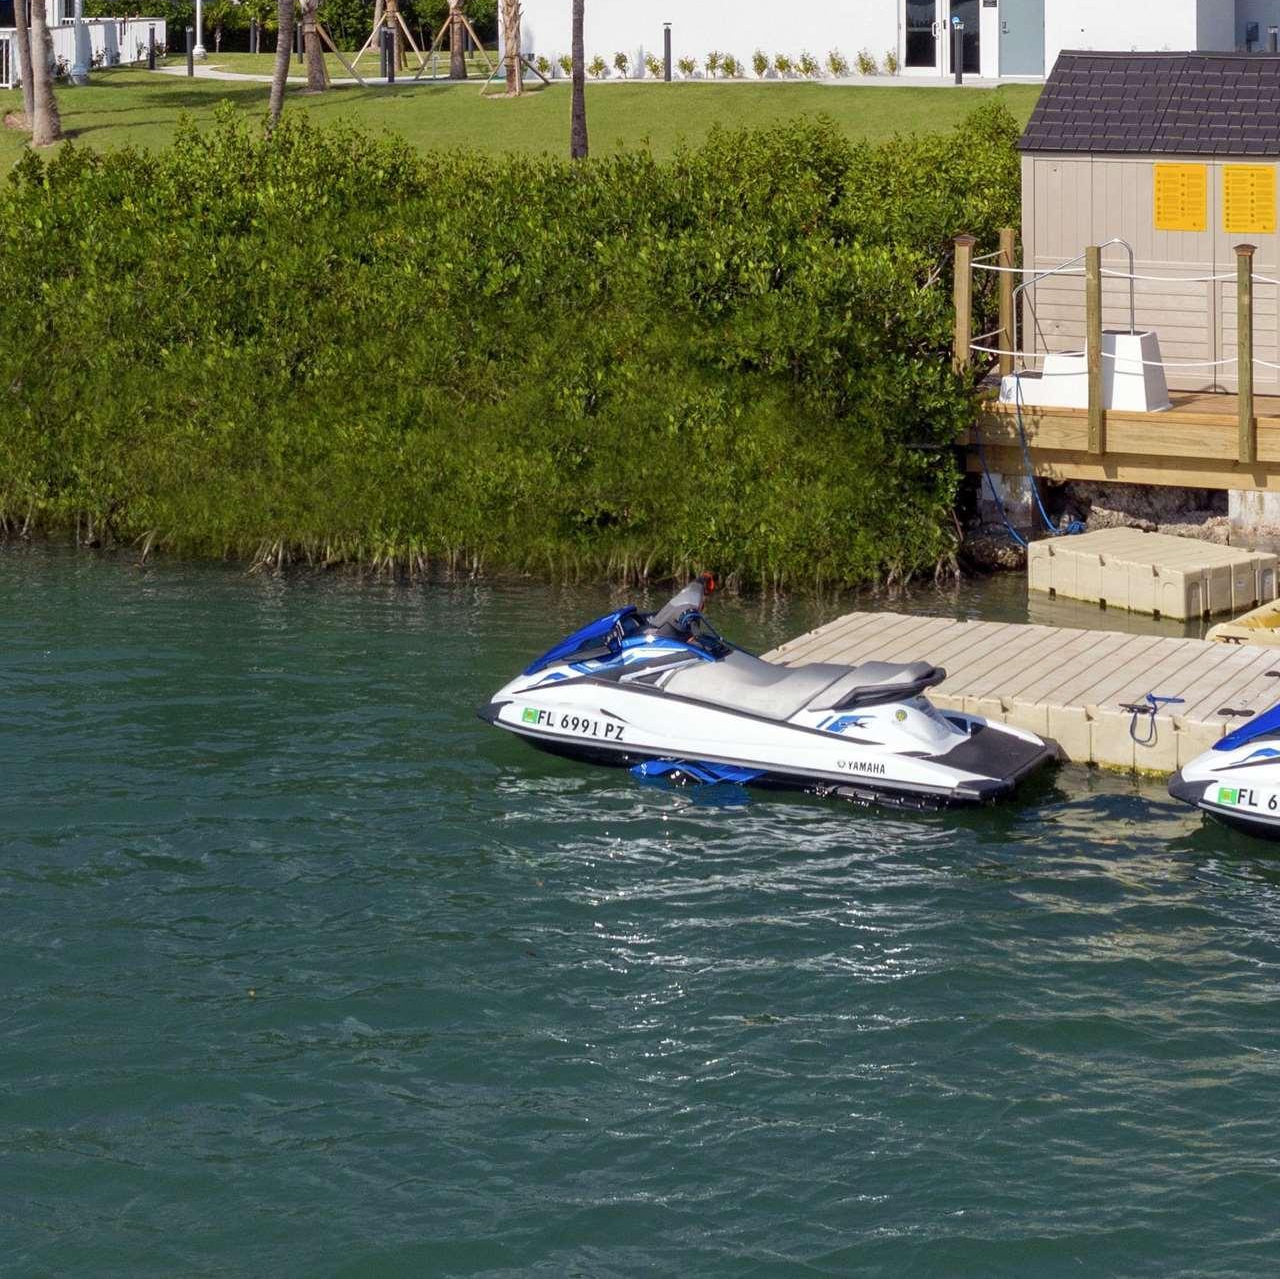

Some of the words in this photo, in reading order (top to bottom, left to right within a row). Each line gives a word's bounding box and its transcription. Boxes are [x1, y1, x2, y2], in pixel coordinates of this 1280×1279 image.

[537, 710, 554, 727] FL
[561, 714, 598, 736] 6991
[605, 723, 624, 741] PZ
[848, 760, 885, 775] YAMAHA
[1237, 788, 1258, 807] FL
